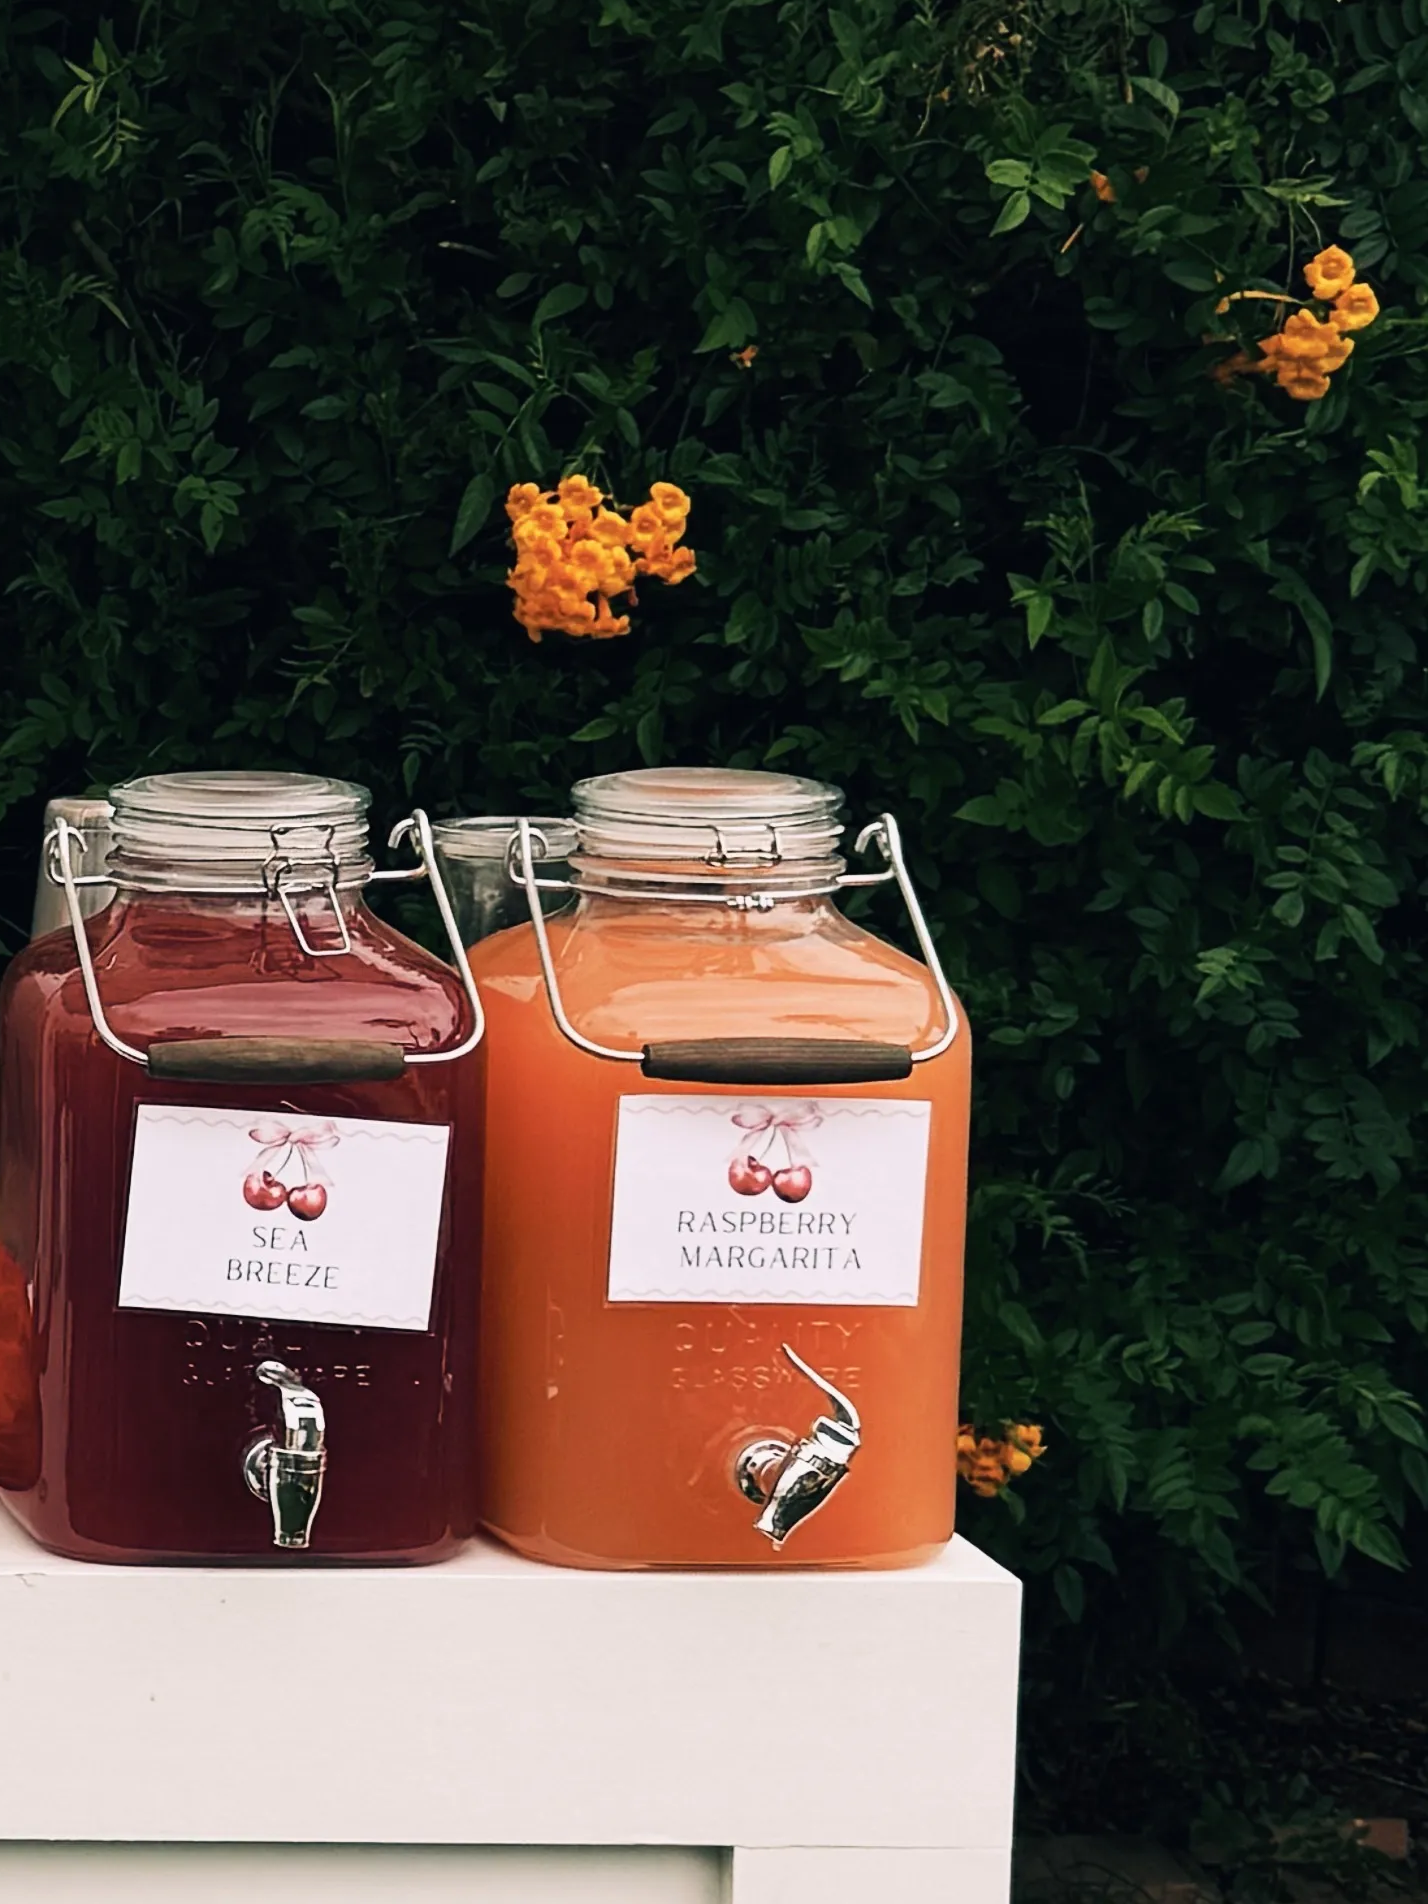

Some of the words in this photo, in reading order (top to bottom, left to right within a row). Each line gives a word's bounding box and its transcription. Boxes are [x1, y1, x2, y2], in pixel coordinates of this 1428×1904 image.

[677, 1210, 857, 1236] RASPBERRY
[252, 1226, 309, 1253] SEA
[679, 1245, 862, 1271] MARGARITA
[226, 1258, 341, 1290] BREEZE
[670, 1365, 862, 1390] GLASSWRE
